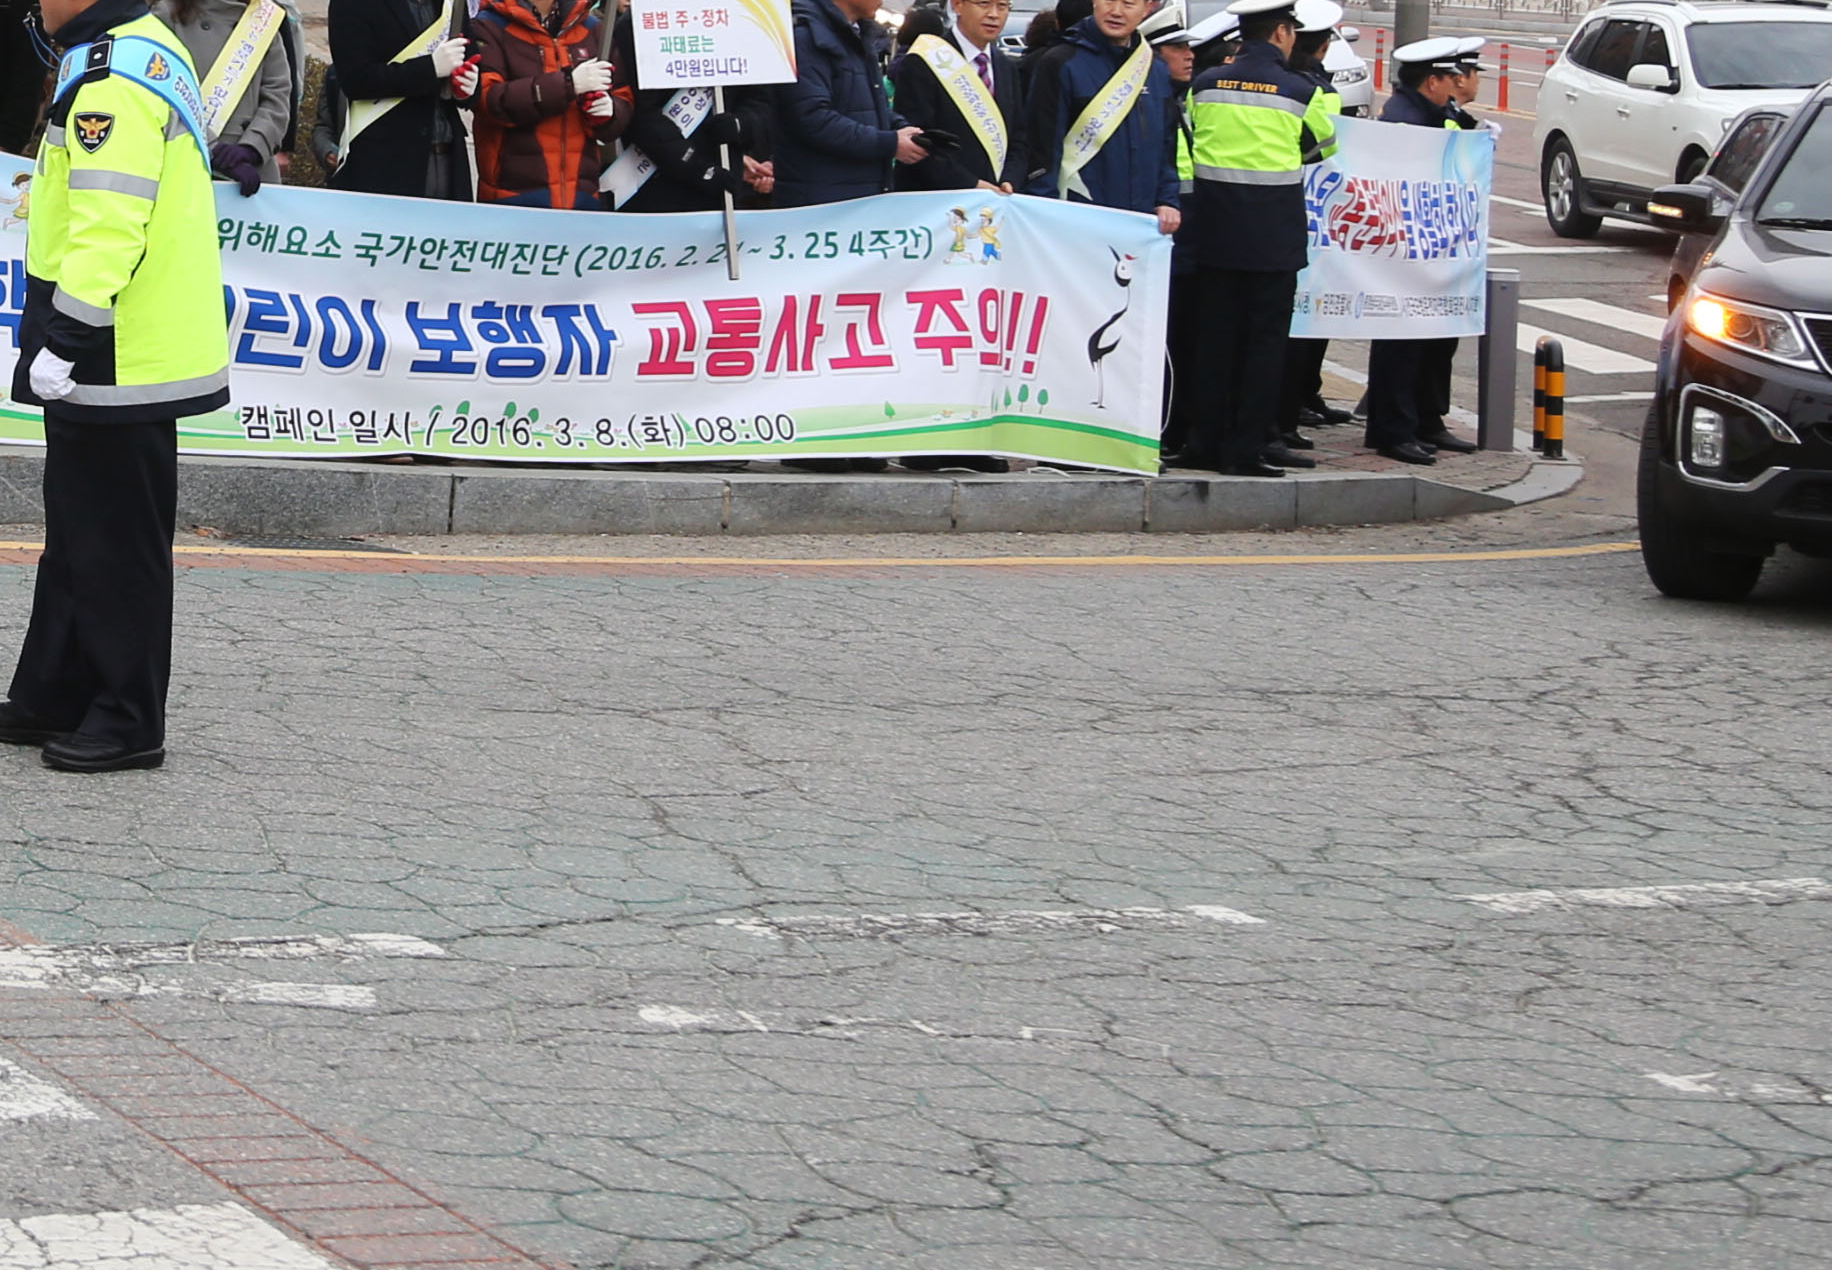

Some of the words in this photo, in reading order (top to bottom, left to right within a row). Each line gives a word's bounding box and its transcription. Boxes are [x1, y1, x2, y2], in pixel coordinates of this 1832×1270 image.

[642, 11, 669, 30] 불법
[659, 35, 715, 54] 과태료는
[665, 57, 749, 78] 4만원입니다!
[1216, 79, 1240, 89] BEST
[1241, 81, 1278, 93] DRIVER
[216, 217, 342, 259] 위해요소
[354, 232, 568, 276] 국가안전대진단
[849, 226, 933, 261] 4주간)
[223, 284, 386, 372] 린이
[406, 300, 617, 379] 보행자
[631, 293, 894, 378] 교통사고
[240, 405, 338, 441] 캠페인
[350, 410, 411, 446] 일시
[697, 414, 796, 444] 08:00
